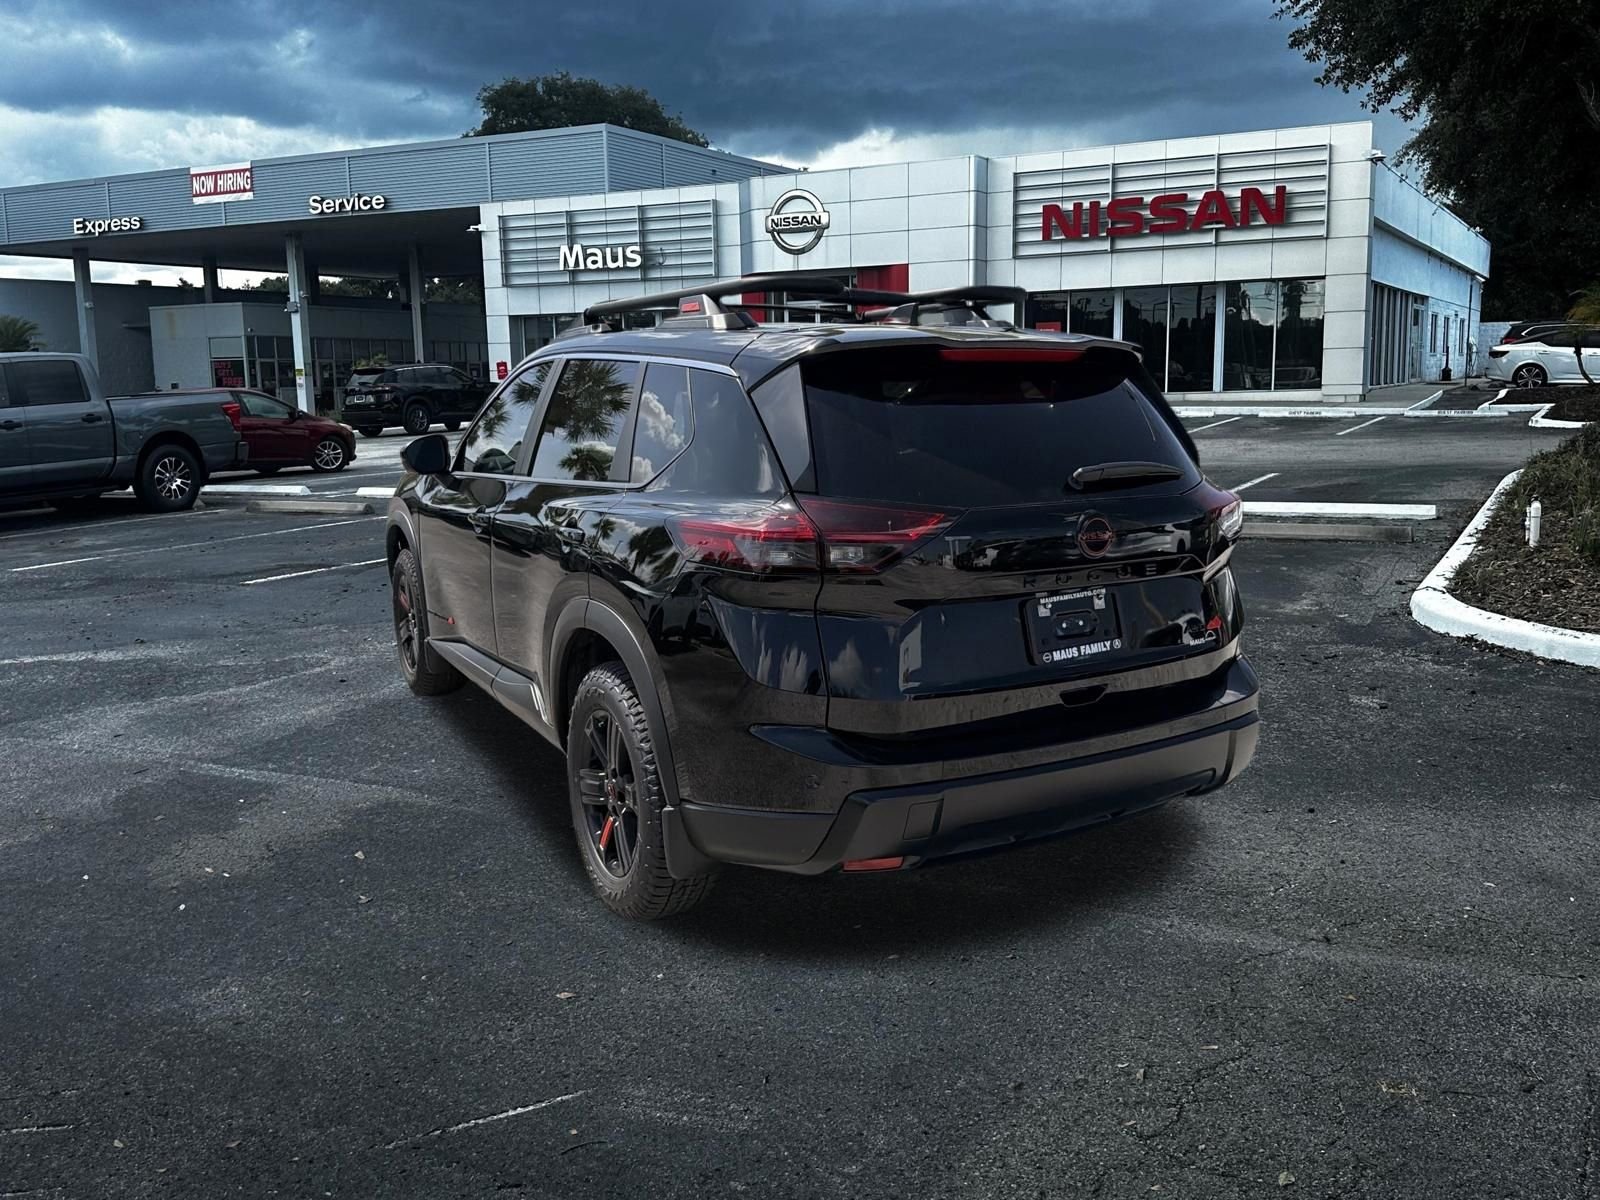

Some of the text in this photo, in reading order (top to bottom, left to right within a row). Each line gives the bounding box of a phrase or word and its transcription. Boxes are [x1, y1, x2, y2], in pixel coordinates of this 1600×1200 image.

[193, 171, 251, 194] NOW HIRING
[309, 193, 385, 214] Service
[1042, 185, 1286, 241] NISSAN
[73, 216, 141, 236] Express
[771, 215, 822, 228] NISSAN
[560, 244, 641, 270] Maus
[1023, 563, 1157, 588] ROGUE
[1040, 588, 1106, 604] MAUSFAMILYAUTO.COM
[1052, 640, 1111, 661] MAUS FAMILY
